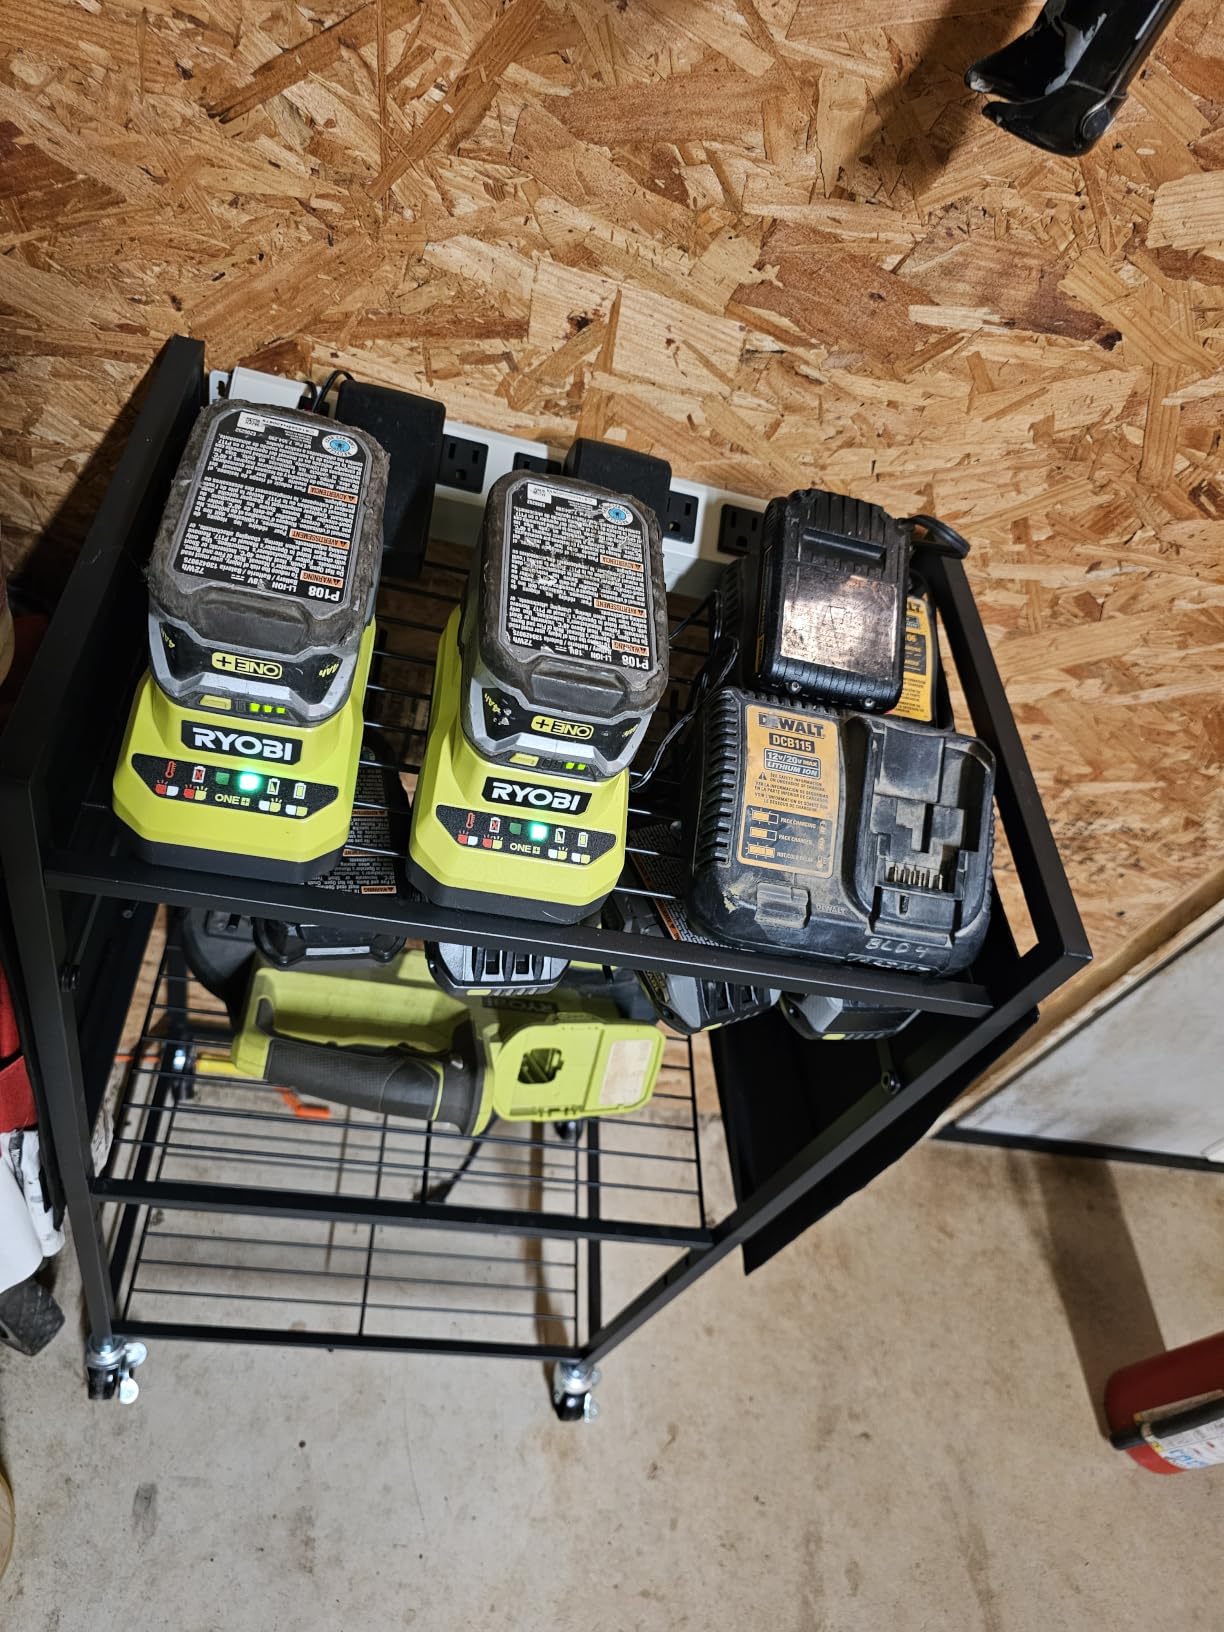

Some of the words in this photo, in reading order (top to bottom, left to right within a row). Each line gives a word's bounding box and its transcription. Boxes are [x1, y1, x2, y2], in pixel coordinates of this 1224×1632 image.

[310, 487, 346, 499] ADVERTENCIA
[292, 530, 338, 545] AVERTISSEMENT
[180, 563, 205, 574] 72Wh
[302, 572, 332, 583] WARNING
[271, 581, 296, 592] LI-ION
[307, 585, 340, 601] P108
[512, 636, 532, 646] 72Wh
[318, 662, 340, 678] 4Ah
[192, 728, 292, 761] RYOBI
[772, 735, 811, 751] DCB115
[767, 761, 800, 773] LITHIUM
[802, 768, 817, 776] ION
[492, 782, 581, 811] RYOBI
